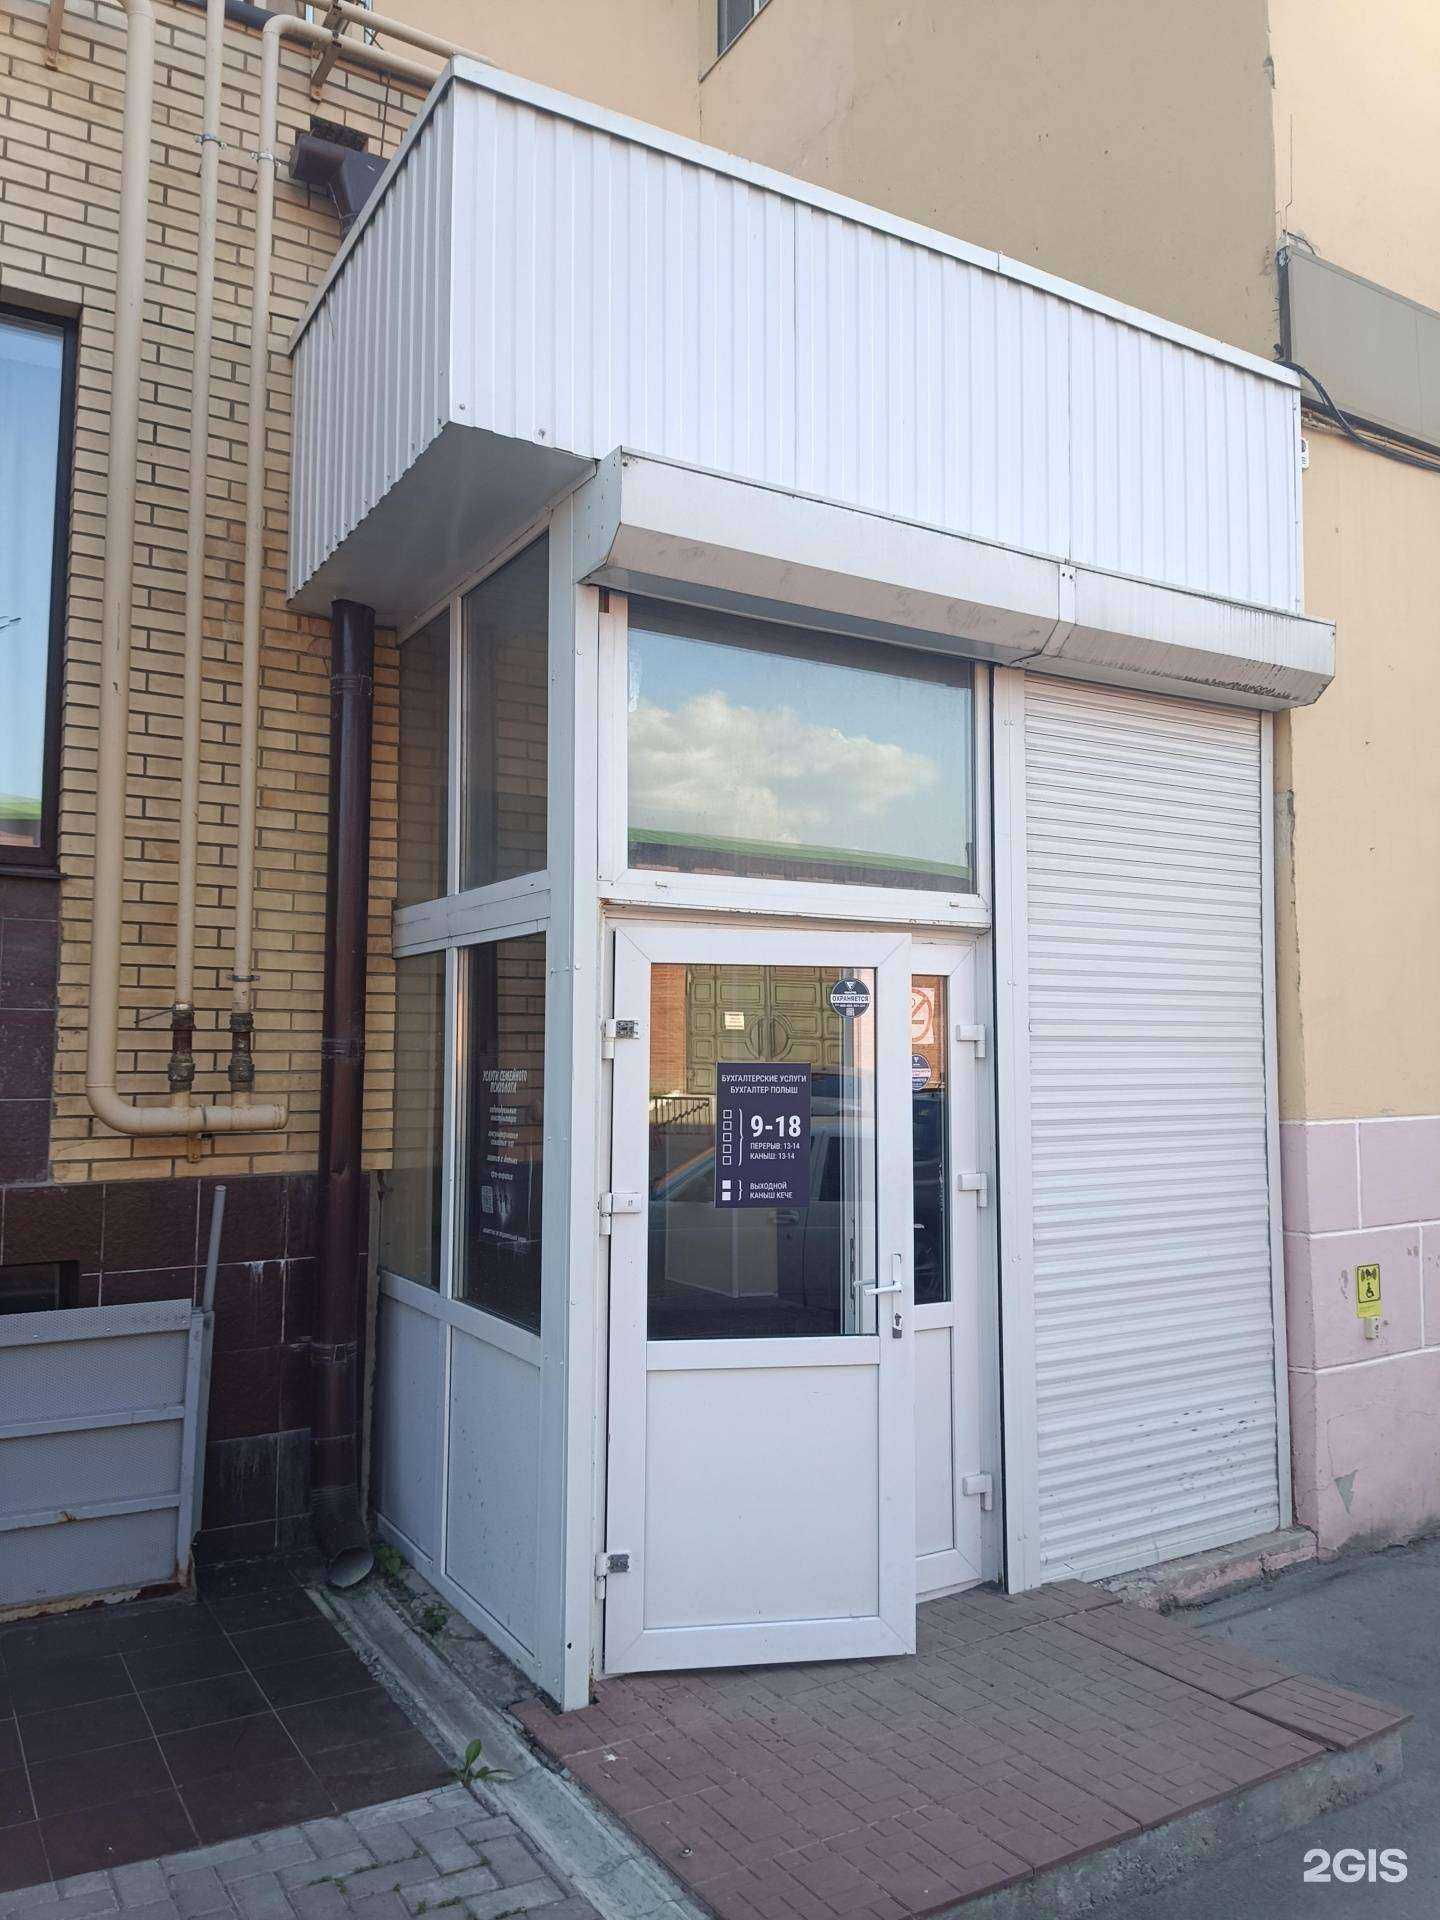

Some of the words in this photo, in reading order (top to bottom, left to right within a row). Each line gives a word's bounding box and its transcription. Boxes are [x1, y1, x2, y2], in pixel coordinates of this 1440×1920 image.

[721, 1074, 778, 1083] БУХГАЛТЕРСКИЕ
[780, 1074, 807, 1083] УСЛУГИ
[730, 1086, 769, 1094] БУХГАЛТЕР
[770, 1086, 798, 1094] ПОЛЫШ
[750, 1114, 802, 1138] 9-18
[750, 1142, 782, 1150] ПЕРЕРЫВ:
[784, 1142, 800, 1150] 13-14
[749, 1181, 787, 1190] ВЫХОДНОЙ
[749, 1191, 775, 1199] КАНЫШ
[776, 1191, 793, 1199] КЕЧЕ
